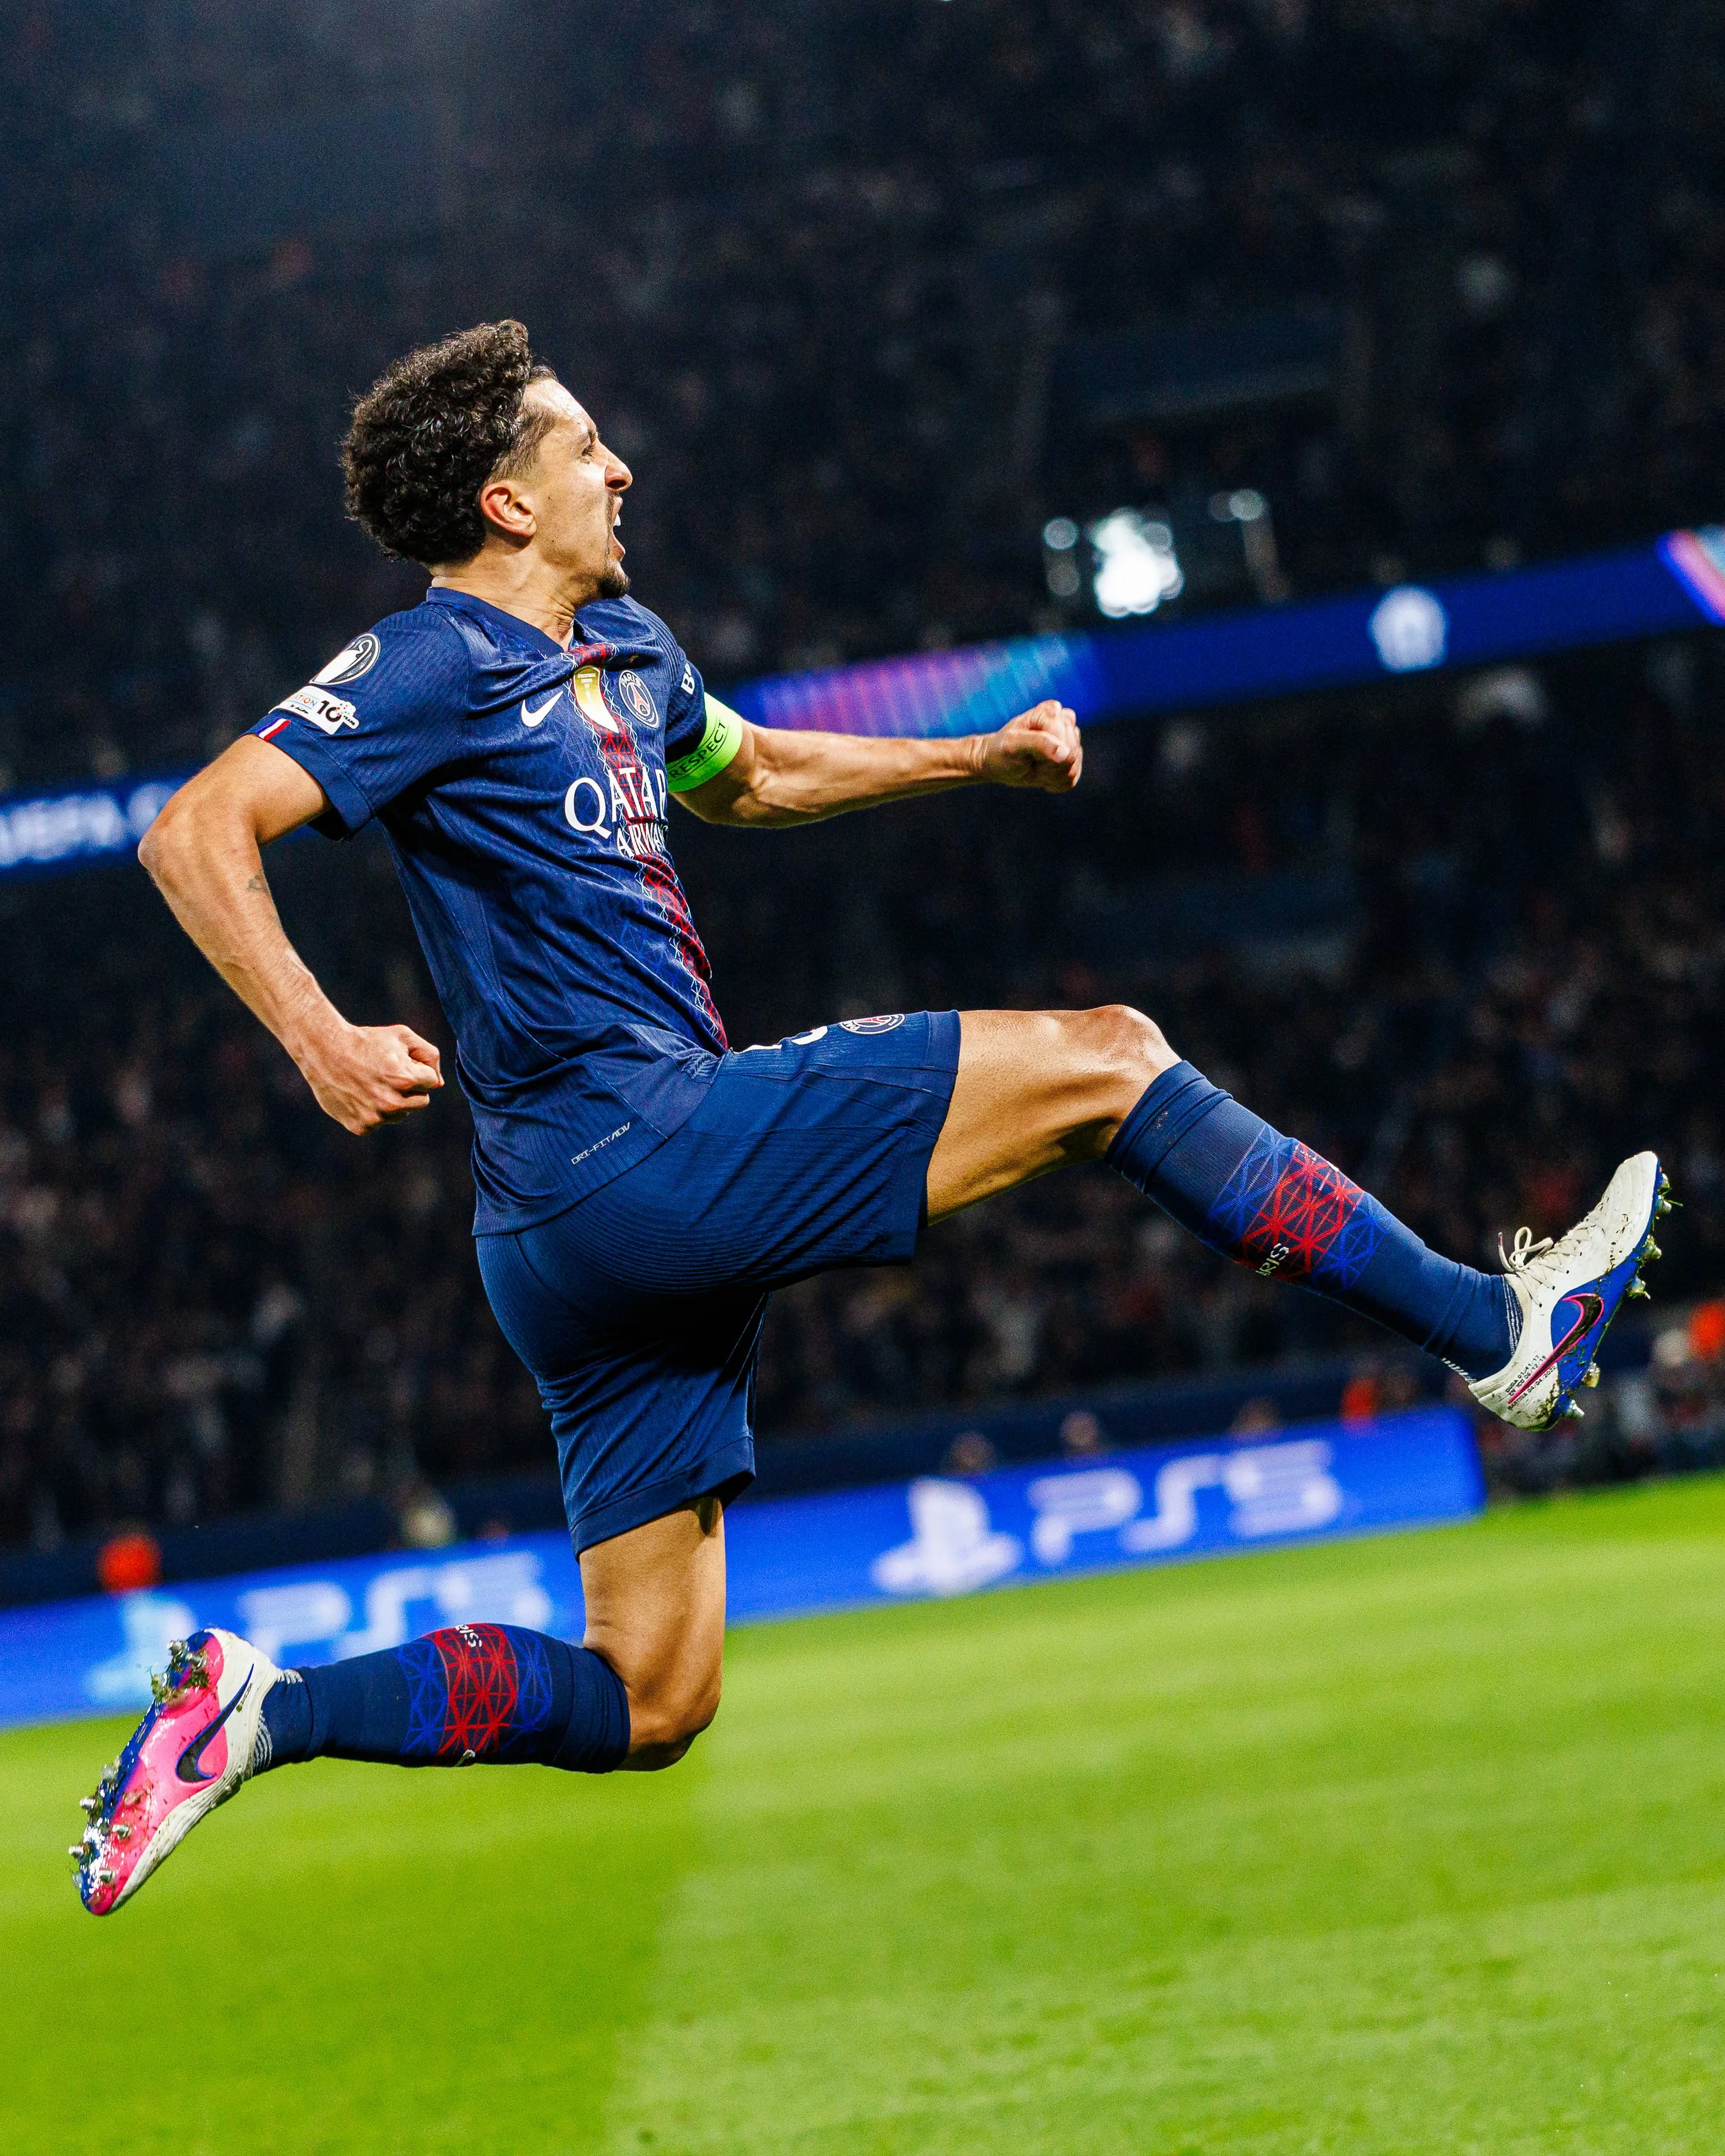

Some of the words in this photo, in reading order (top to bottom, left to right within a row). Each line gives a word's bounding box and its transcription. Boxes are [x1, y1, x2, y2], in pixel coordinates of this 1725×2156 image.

[344, 715, 355, 726] YEARS
[669, 722, 725, 778] RESPECT
[1026, 1438, 1344, 1565] PS5
